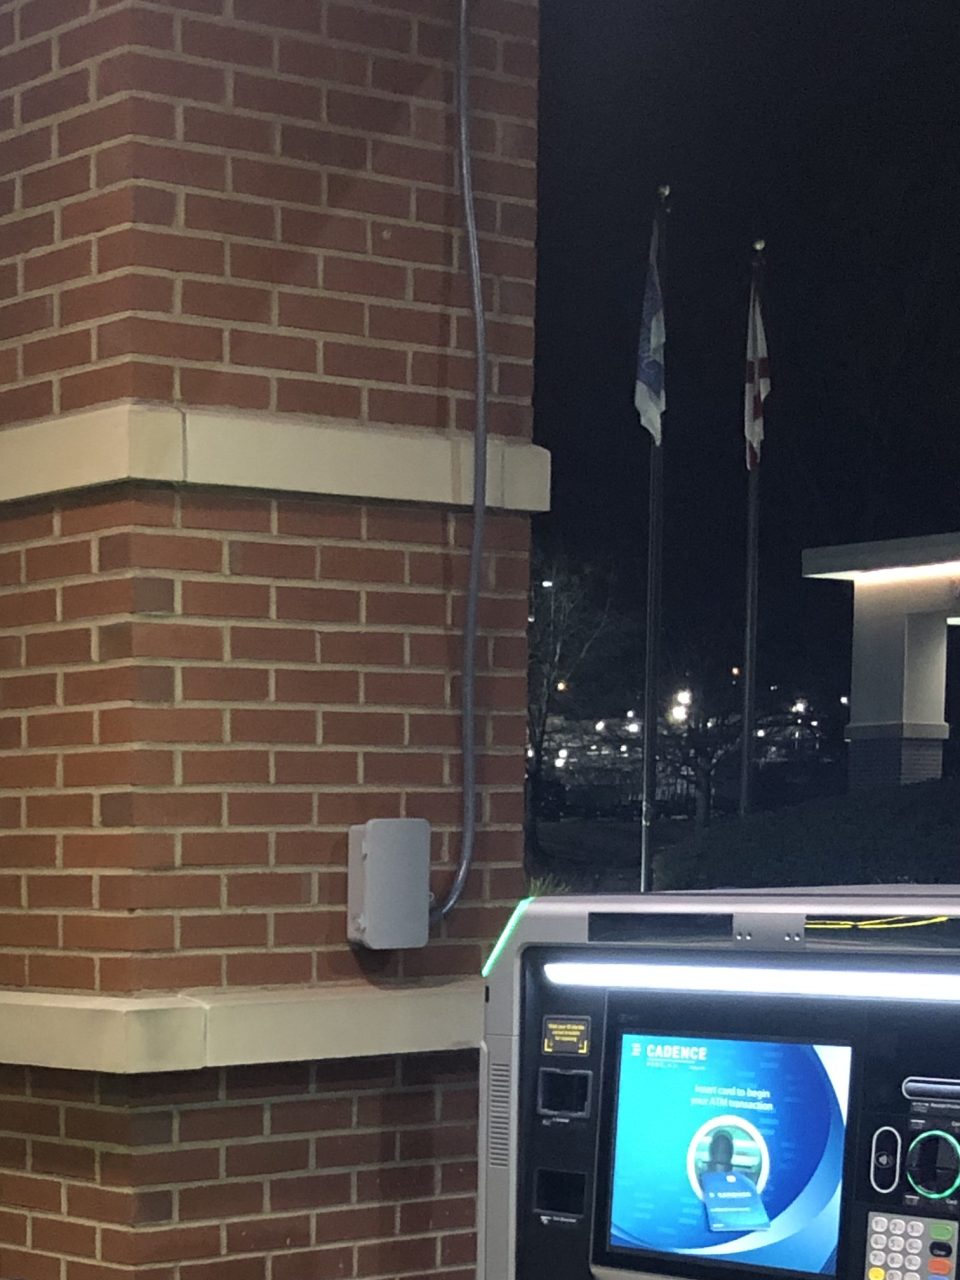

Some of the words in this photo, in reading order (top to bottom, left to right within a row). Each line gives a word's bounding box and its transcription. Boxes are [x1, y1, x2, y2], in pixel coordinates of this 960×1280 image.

[646, 1043, 708, 1061] CADENCE
[736, 1087, 746, 1096] to
[746, 1088, 771, 1100] begin
